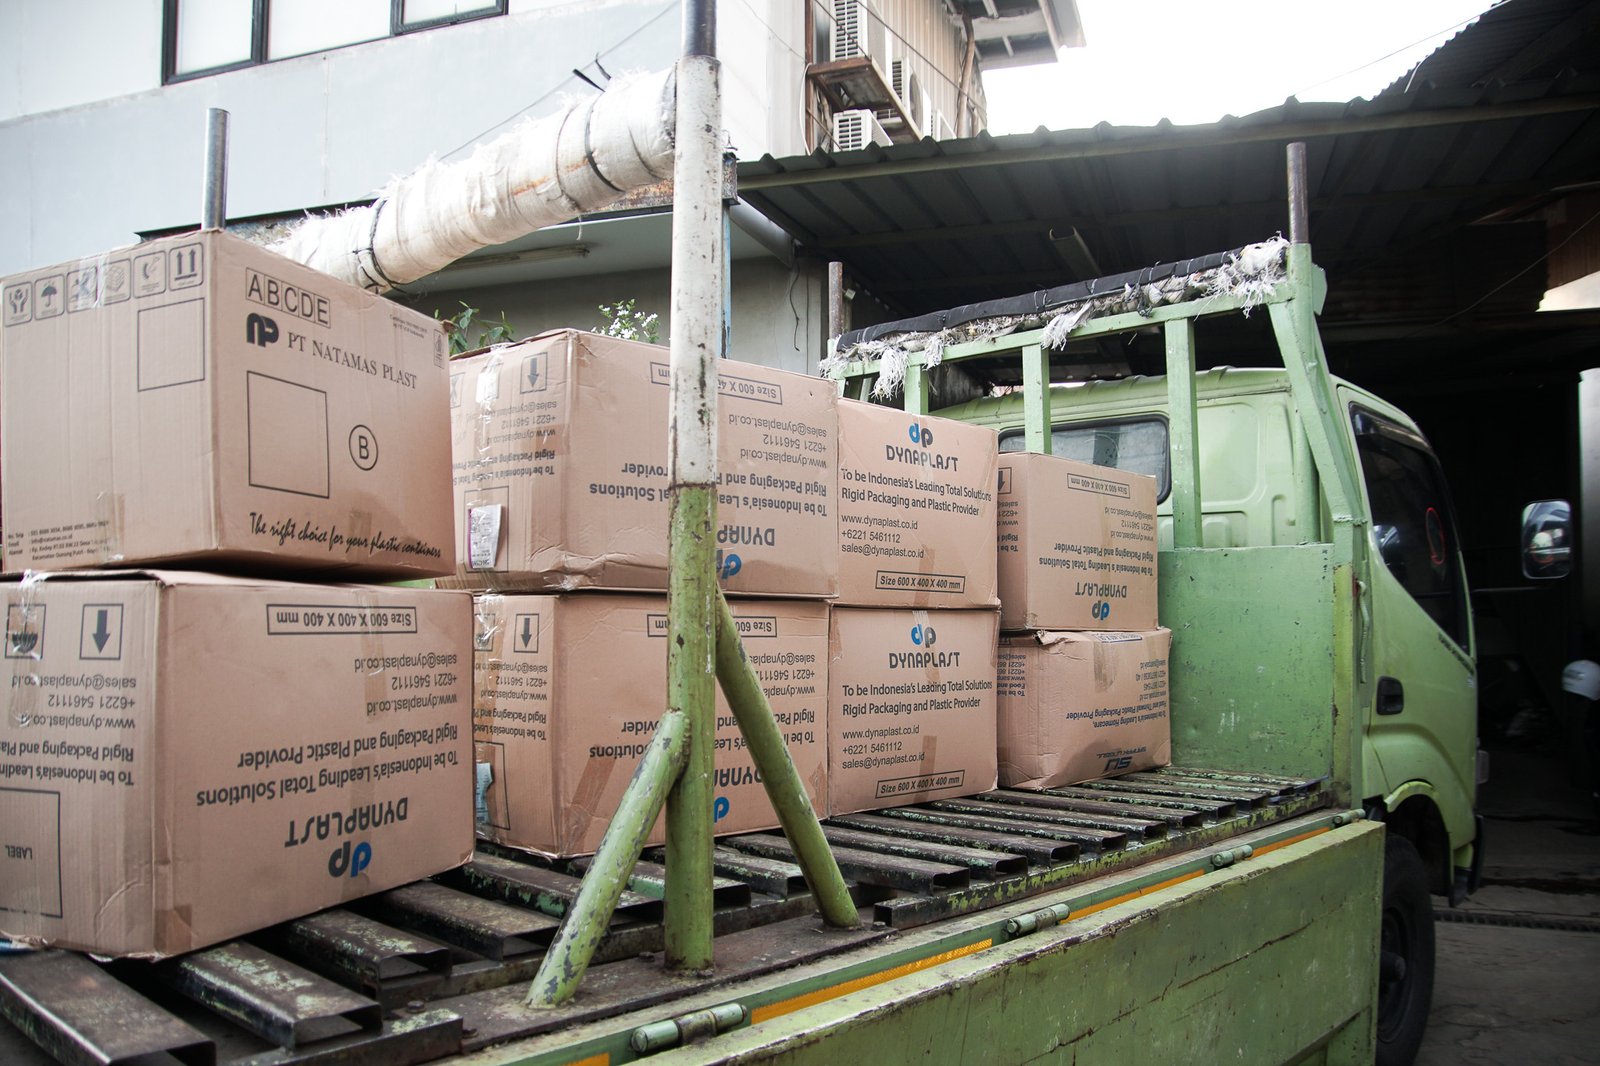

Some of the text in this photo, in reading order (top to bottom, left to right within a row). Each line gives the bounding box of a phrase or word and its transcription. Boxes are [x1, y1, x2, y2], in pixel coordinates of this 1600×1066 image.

[288, 332, 417, 389] PT NATAMAS PLAST
[728, 414, 827, 438] sales@dynaplast.co.id
[358, 435, 370, 460] B
[763, 434, 827, 453] +6221 5461112
[740, 448, 827, 468] www.dynaplast.co.id
[886, 444, 959, 472] DYNAPLAST
[726, 473, 746, 486] and
[750, 474, 802, 493] Packaging
[841, 468, 992, 502] To be Indonesia's Leading Total Solutions
[589, 483, 655, 502] Solutions
[805, 481, 827, 497] Rigid
[750, 494, 802, 511] Indonesia's
[802, 501, 815, 514] be
[816, 503, 827, 516] To
[841, 487, 865, 502] Rigid
[867, 490, 909, 509] Packaging
[911, 497, 927, 509] and
[928, 498, 951, 512] Plastic
[952, 501, 980, 517] Provider
[841, 514, 918, 530] www.dynaplast.co.id
[249, 512, 441, 558] The right choice for your plastic containers
[717, 525, 775, 546] DYNAP
[841, 528, 901, 543] +6221 5461112
[841, 543, 924, 558] sales@dynaplast.co.id
[1054, 543, 1154, 562] Rigid Packaging and Plastic Provider
[1039, 557, 1071, 570] Solutions
[1072, 560, 1087, 571] Total
[1088, 560, 1111, 572] Leading
[1141, 566, 1148, 576] be
[1147, 567, 1154, 577] To
[880, 575, 960, 589] Size 600 X 400 X 400 mm
[1075, 582, 1127, 598] DYNAPLAST
[276, 611, 411, 627] Size 600 X 400 X 400 mm
[354, 652, 457, 672] sales@dynaplast.co.id
[889, 652, 960, 669] DYNAPLAST
[391, 673, 457, 690] +6221 5461112
[791, 668, 815, 679] +6221
[496, 676, 548, 688] +6221 5461112
[842, 679, 993, 697] To be Indonesia's Leading Total Solutions
[48, 694, 135, 709] +6221 5461112
[367, 694, 458, 716] www.dynaplast.co.id
[842, 696, 981, 718] Rigid Packaging and Plastic Provider
[492, 708, 527, 723] Packaging
[528, 711, 547, 724] Rigid
[793, 709, 815, 725] Rigid
[1066, 711, 1094, 721] Provider
[1094, 708, 1121, 718] Packaging
[717, 717, 737, 731] and
[842, 724, 920, 740] www.dynaplast.co.id
[1092, 719, 1120, 729] Homecare,
[473, 724, 547, 741] To be Indonesia's Lead
[791, 733, 803, 745] be
[804, 731, 815, 744] To
[19, 743, 40, 756] and
[42, 740, 99, 760] Packaging
[102, 744, 134, 762] Rigid
[237, 723, 458, 771] Rigid Packaging and Plastic Provider
[842, 741, 902, 755] +6221 5461112
[842, 752, 925, 769] sales@dynaplast.co.id
[0, 764, 134, 786] To be Indonesia's Leadin
[196, 750, 458, 807] To be Indonesia's Leading Total Solutions
[880, 776, 960, 794] Size 600 X 400 X 400 mm
[284, 797, 408, 848] DYNAPLAST
[5, 845, 33, 860] LABEL
